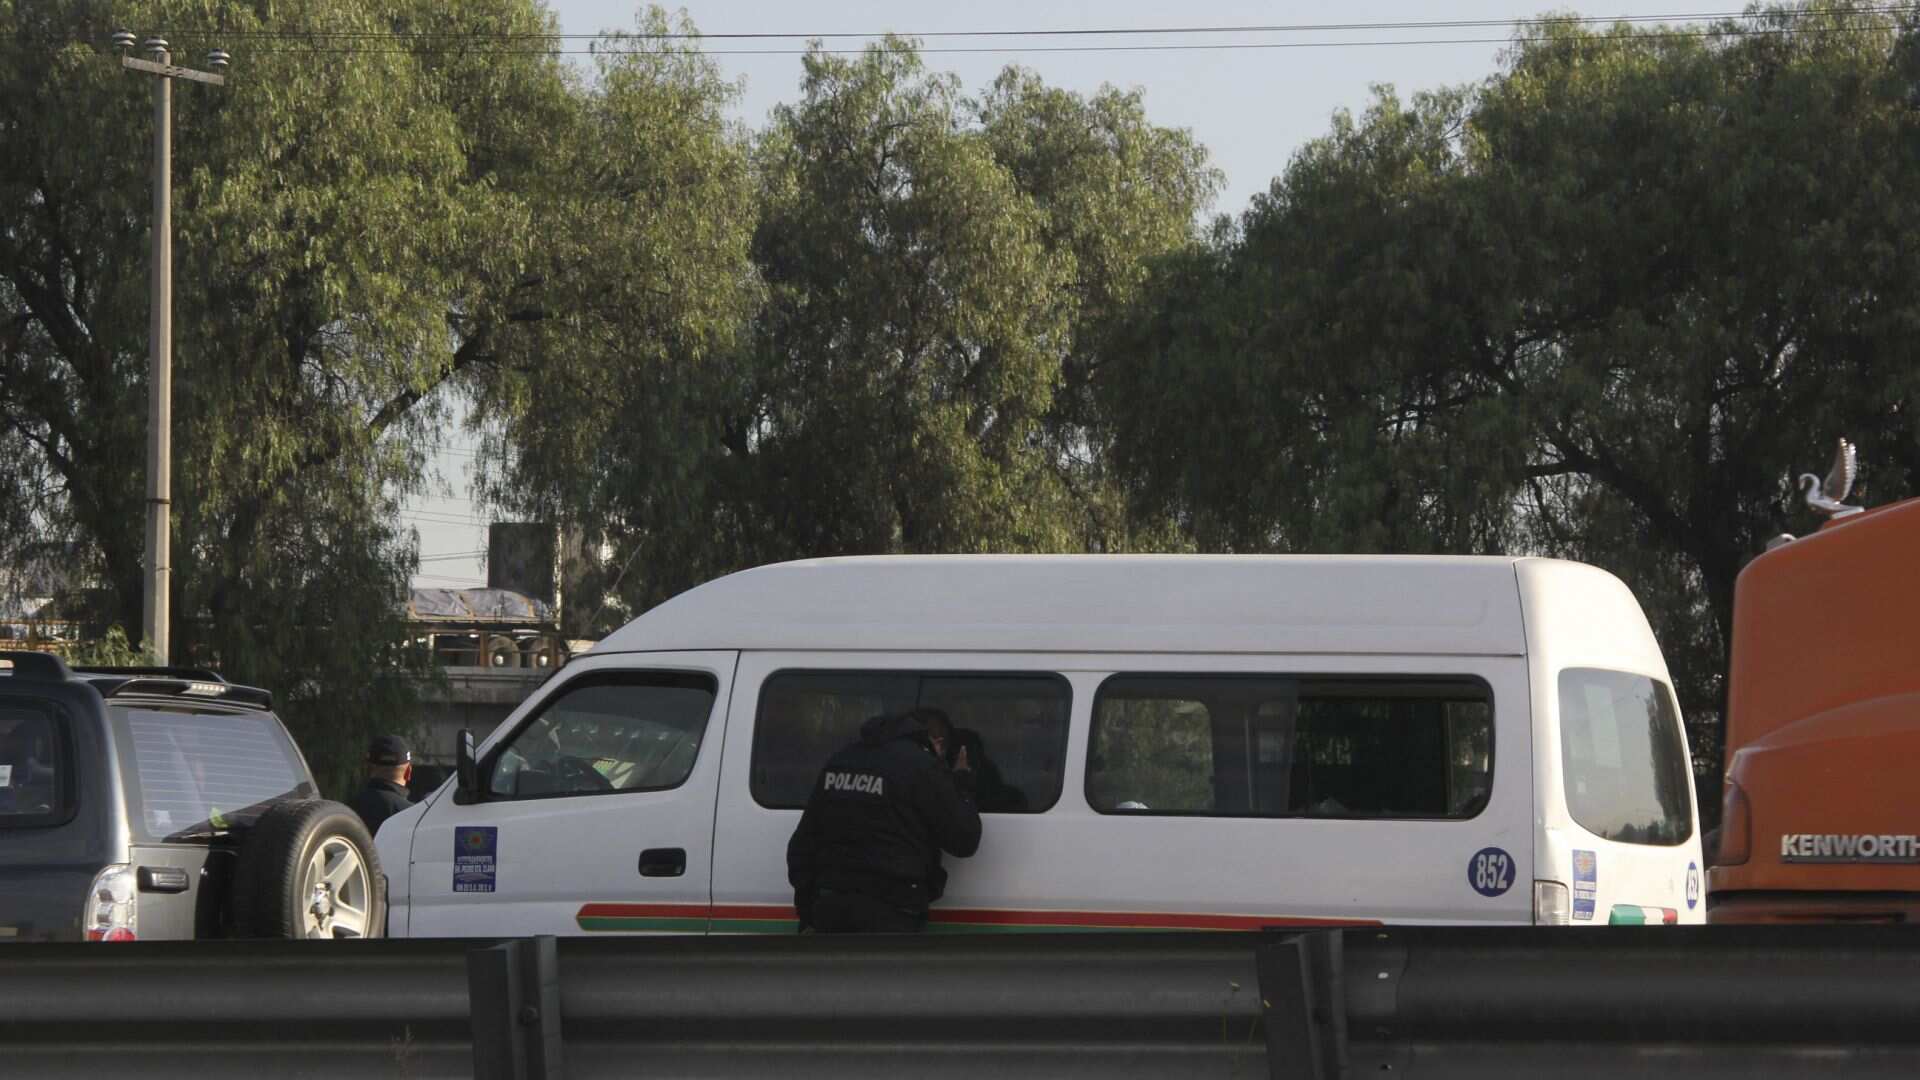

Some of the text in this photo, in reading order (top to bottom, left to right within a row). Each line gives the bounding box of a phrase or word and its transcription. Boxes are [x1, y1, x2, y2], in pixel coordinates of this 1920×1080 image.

[824, 772, 883, 795] POLICIA
[1781, 834, 1920, 856] KENWORTH
[1477, 854, 1507, 888] 852
